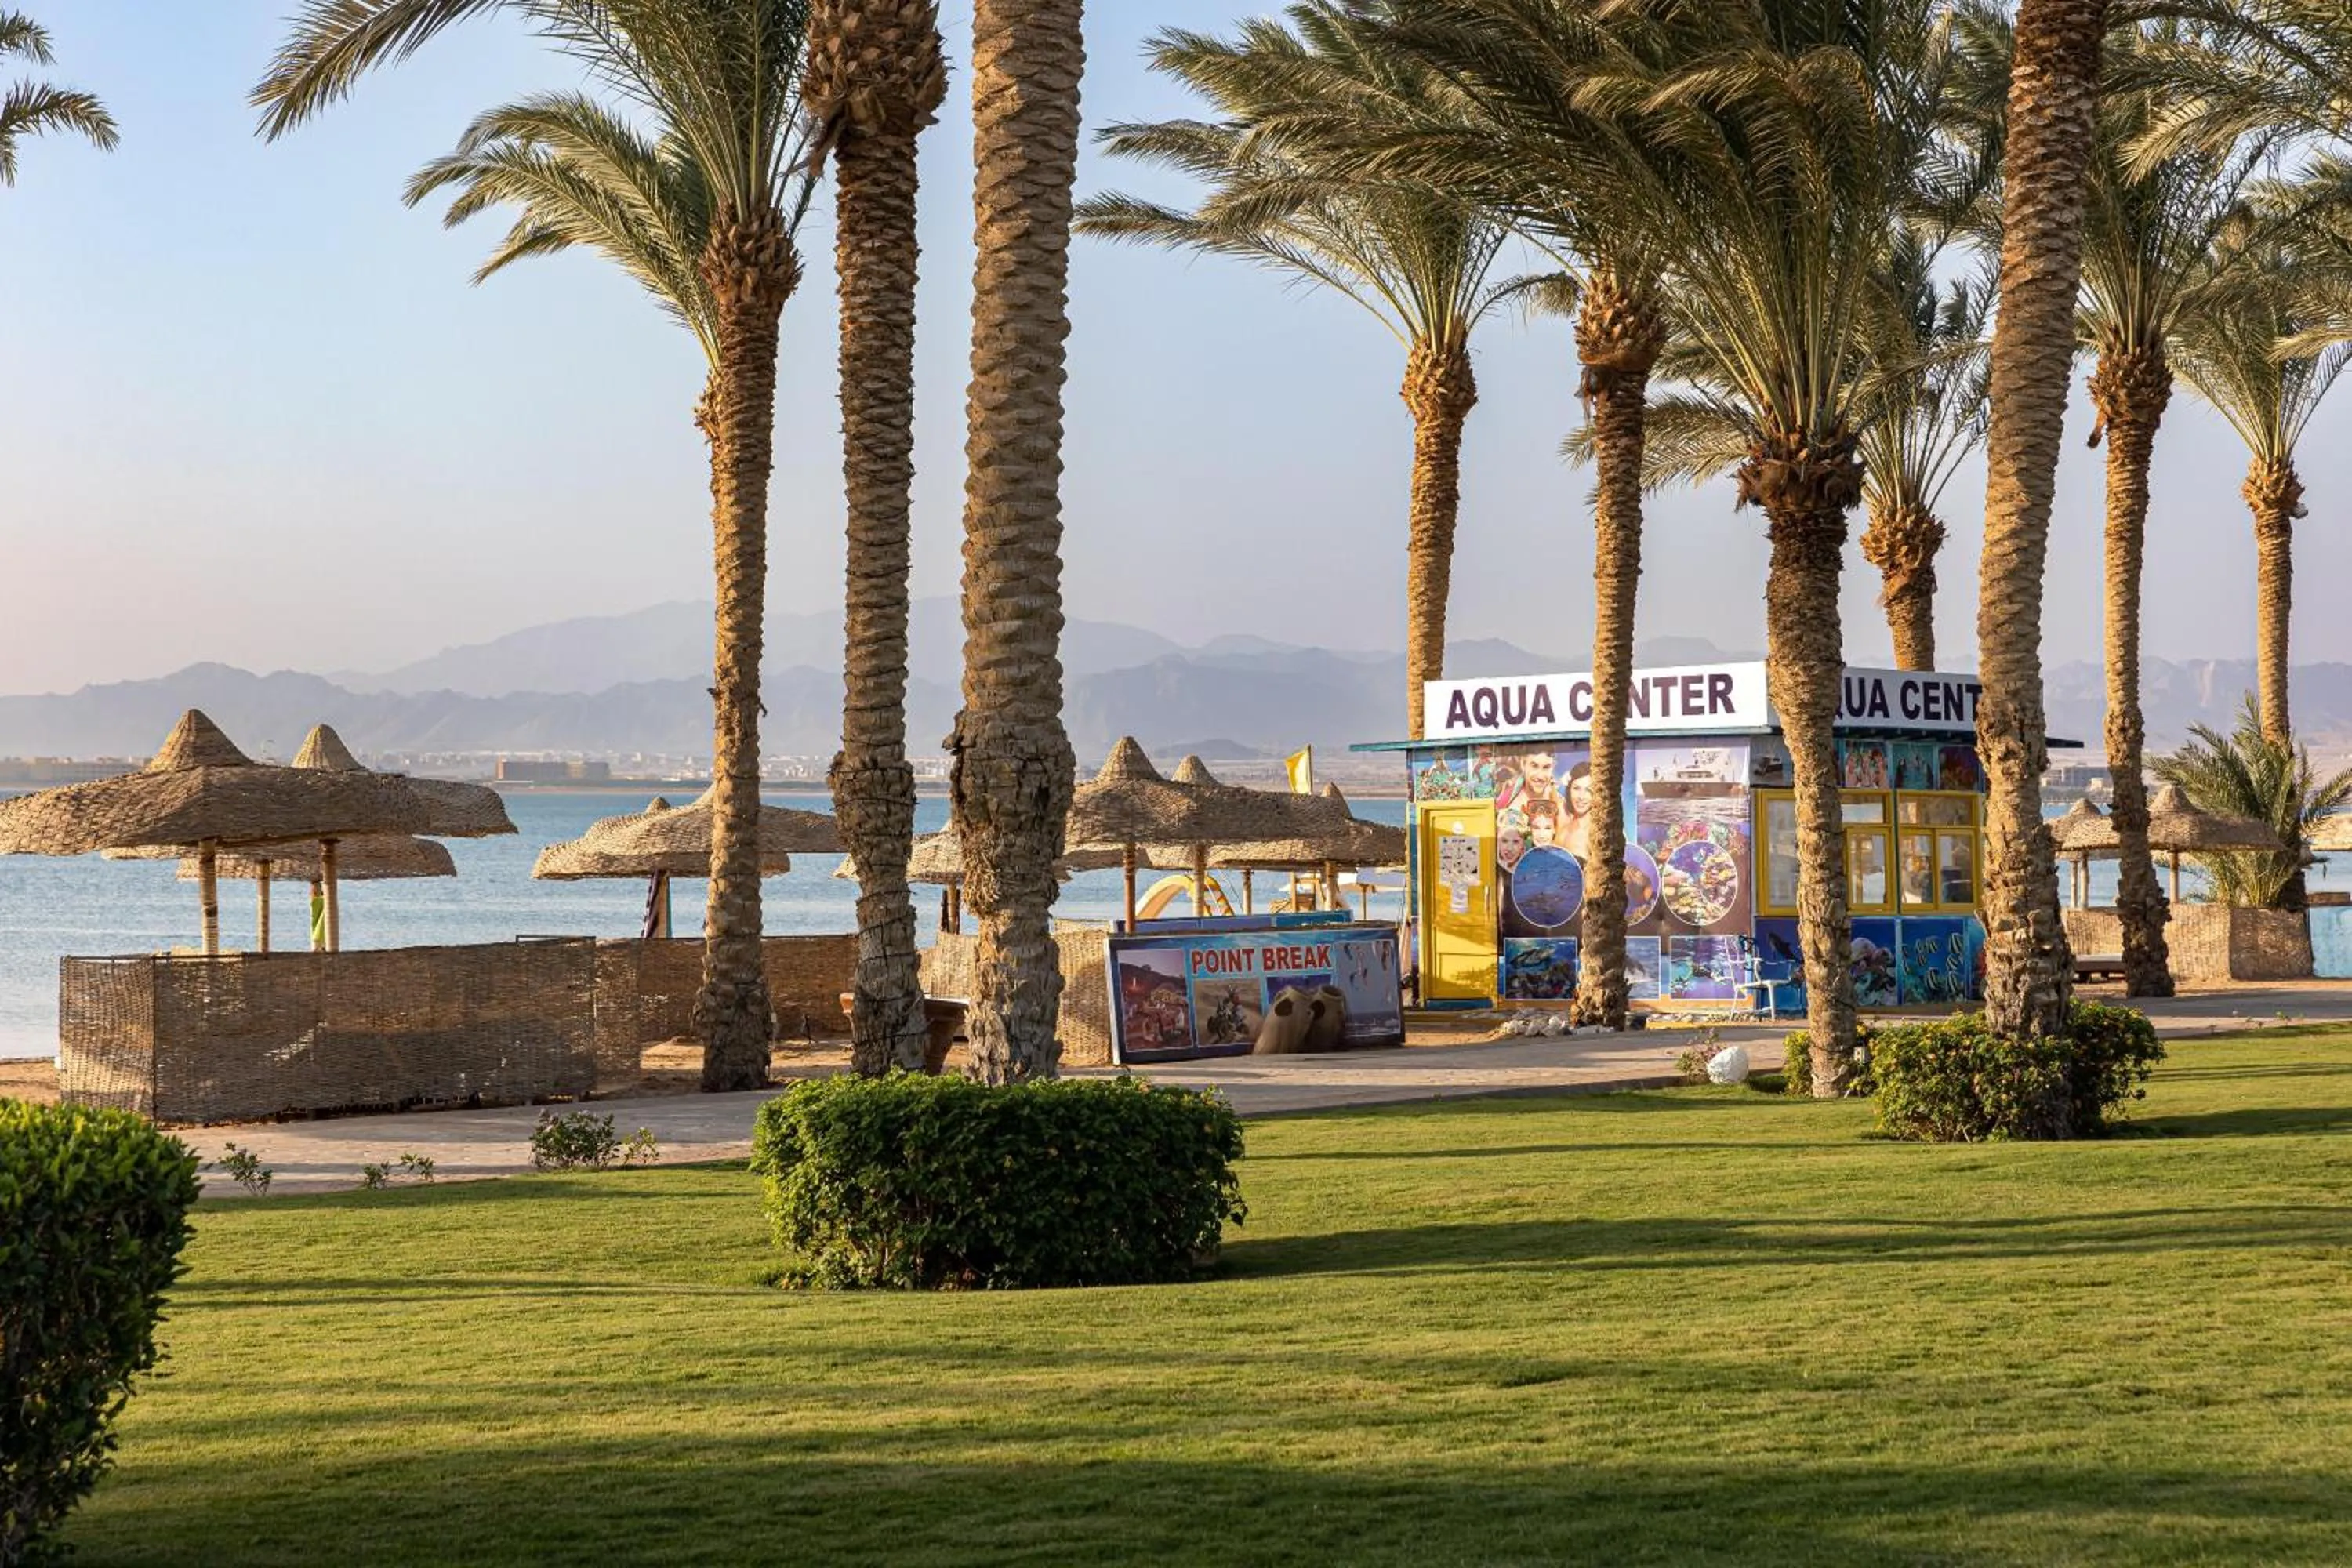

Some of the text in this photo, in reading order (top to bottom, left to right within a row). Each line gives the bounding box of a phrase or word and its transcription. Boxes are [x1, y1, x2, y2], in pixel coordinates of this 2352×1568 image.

[1446, 673, 1736, 730] AQUA CNTER
[1835, 677, 1983, 722] UA CENT
[1191, 945, 1331, 974] POINT BREAK
